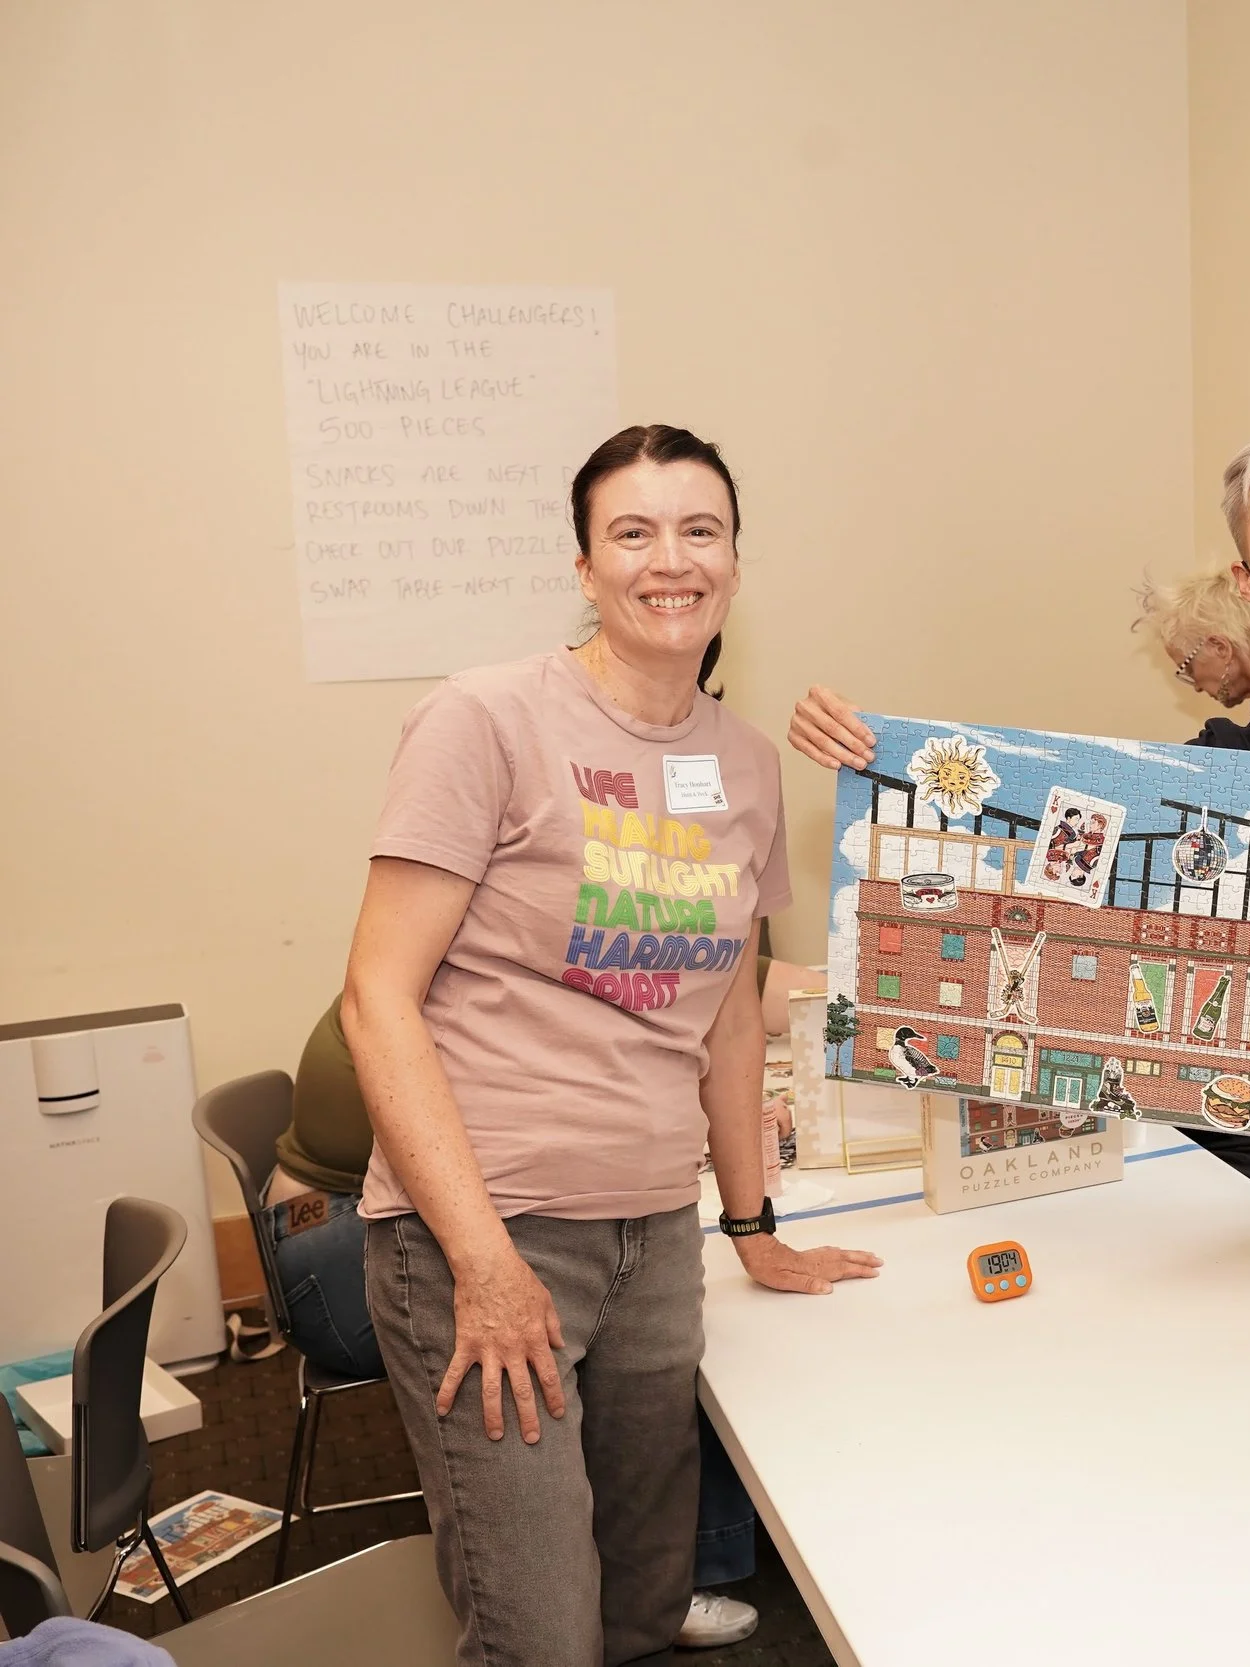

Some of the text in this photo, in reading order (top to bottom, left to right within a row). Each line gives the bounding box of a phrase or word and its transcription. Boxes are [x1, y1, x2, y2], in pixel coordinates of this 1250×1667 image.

[292, 300, 600, 336] WELCOME CHALLENGERS!
[291, 339, 492, 371] YOU ARE IN THE
[399, 416, 485, 440] PIECES
[305, 462, 395, 489] SNACKS
[420, 463, 463, 485] ARE
[486, 464, 543, 488] NEXT
[305, 497, 564, 525] RESTROOMS DOWN THE
[304, 540, 364, 564] CHECK
[377, 540, 415, 561] OUT
[431, 536, 469, 558] OUR
[309, 576, 372, 604] SWAP
[570, 761, 639, 809] LIFE
[1052, 795, 1061, 806] K
[583, 841, 741, 897] SUNLIGHT
[574, 883, 717, 935] NATURE
[566, 927, 748, 971] HARMONY
[561, 967, 680, 1011] SPIRIT
[959, 1142, 1104, 1180] OAKLAND
[961, 1160, 1103, 1194] PUZZLE COMPANY
[289, 1200, 325, 1229] Lee
